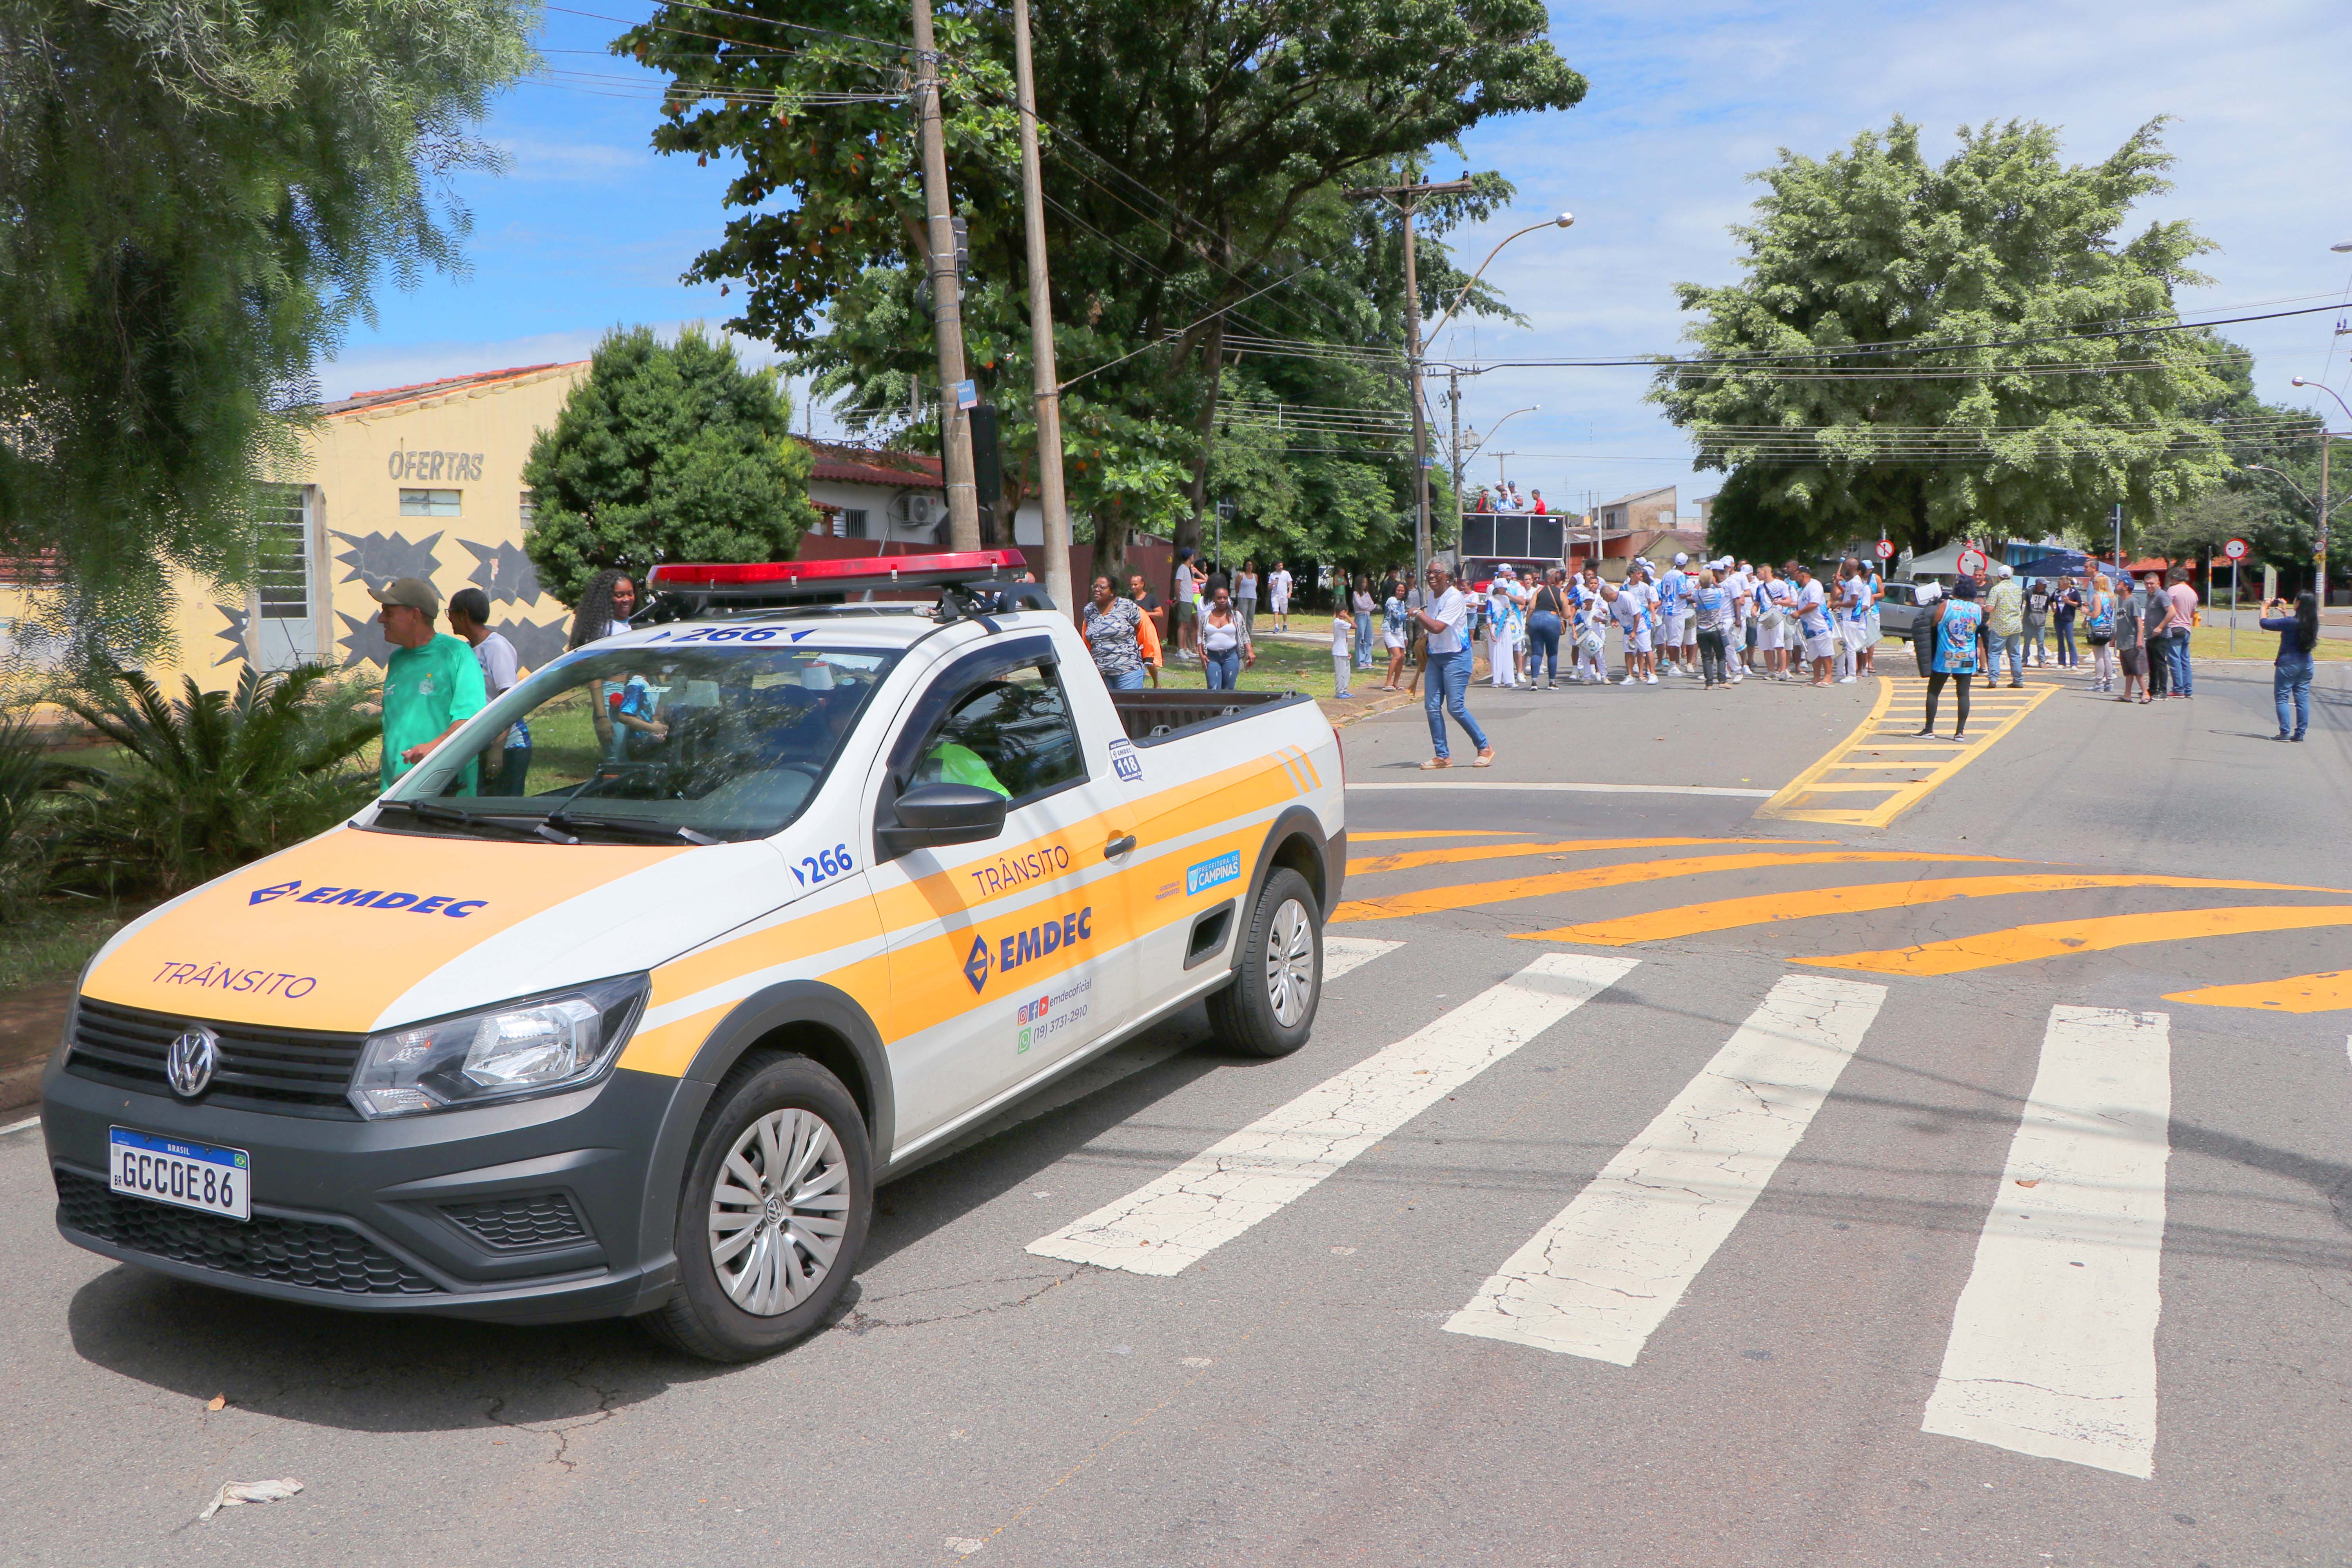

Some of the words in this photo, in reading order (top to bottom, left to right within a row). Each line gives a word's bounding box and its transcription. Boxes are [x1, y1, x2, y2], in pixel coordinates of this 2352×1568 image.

[388, 450, 485, 481] OFERTAS
[670, 627, 789, 643] 266
[1117, 748, 1132, 756] EMDEC
[1117, 757, 1138, 775] 118
[802, 843, 853, 884] 266
[971, 845, 1069, 896] TRÂNSITO
[1198, 858, 1230, 873] PREFEITURA
[1198, 861, 1238, 886] CAMPINAS
[294, 887, 489, 918] EMDEC
[1155, 887, 1180, 901] TRANSPORTES
[1000, 906, 1092, 973] EMDEC
[153, 961, 317, 998] TRÂNSITO
[1049, 978, 1092, 1007] emdecoficial
[1033, 1023, 1048, 1044] (19)
[1049, 1004, 1087, 1033] 3731-2910
[167, 1143, 191, 1155] BRASIL
[114, 1174, 122, 1187] BR
